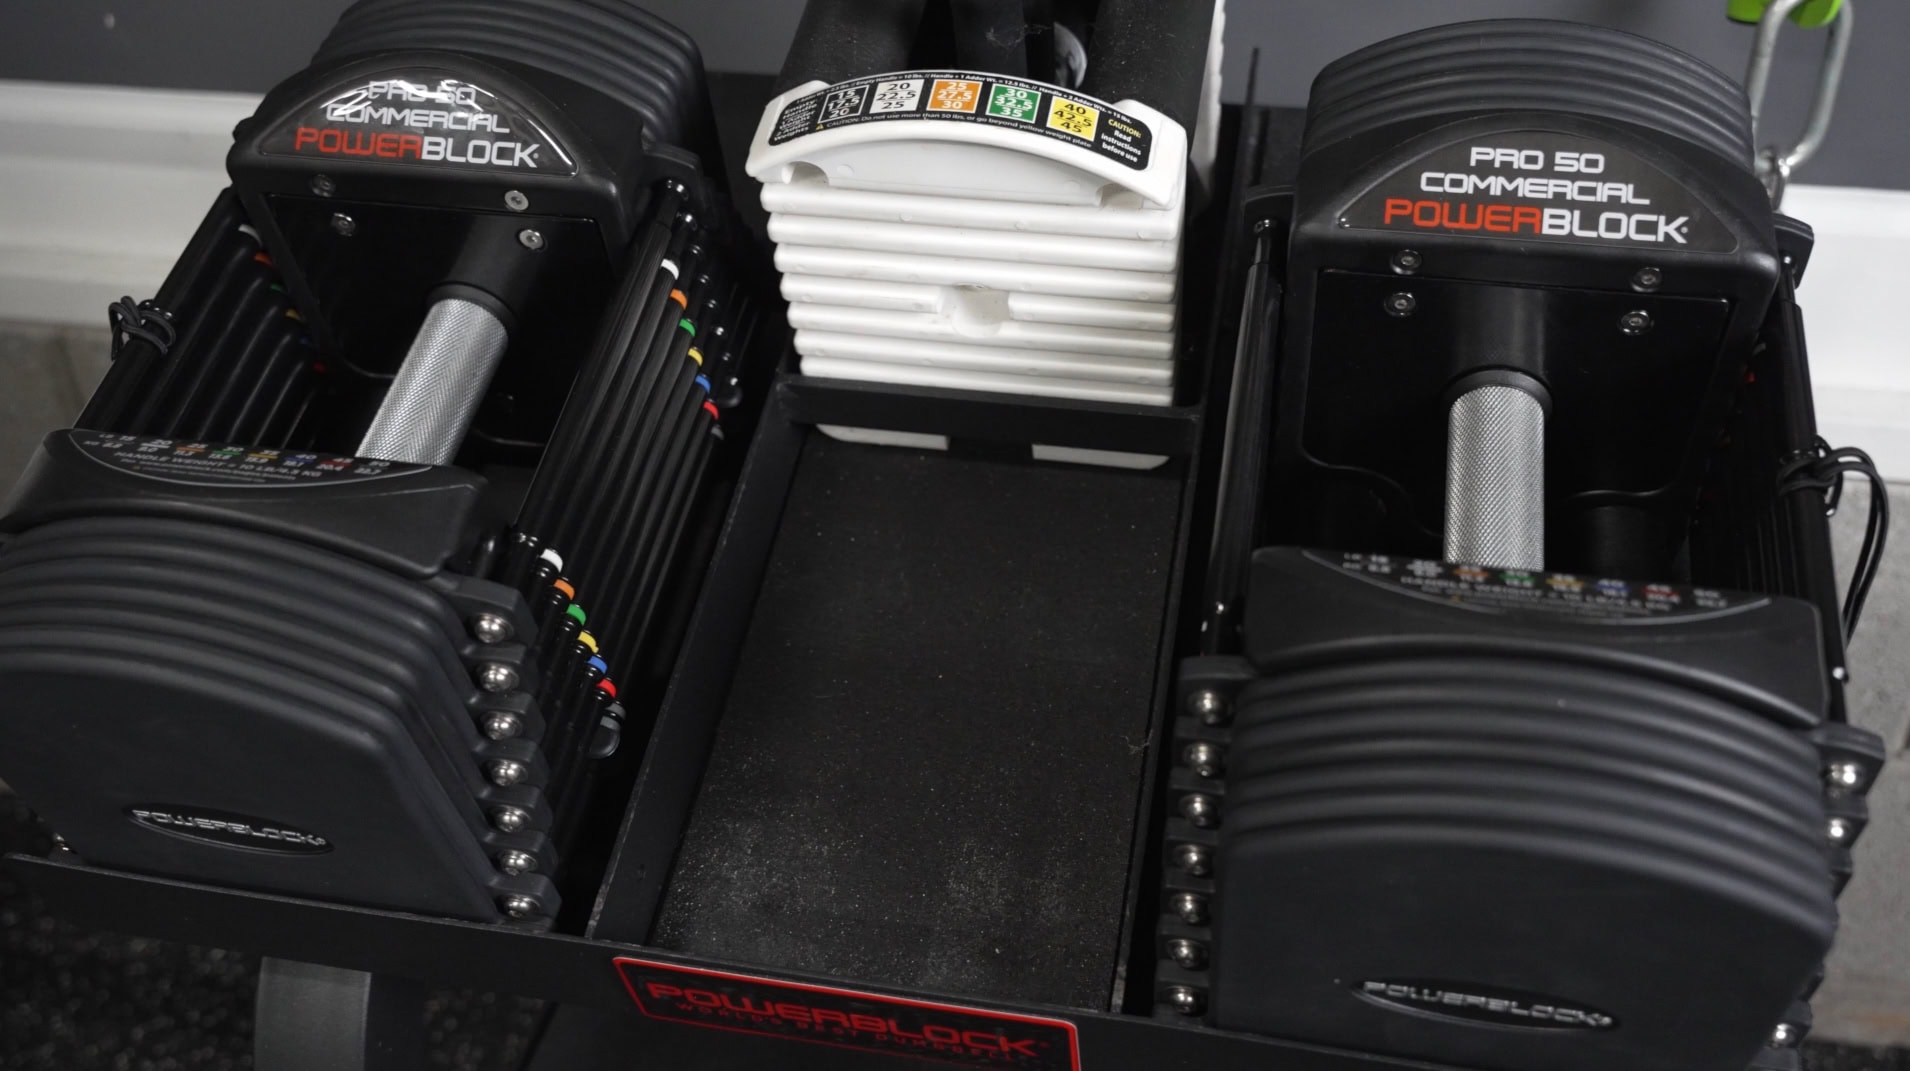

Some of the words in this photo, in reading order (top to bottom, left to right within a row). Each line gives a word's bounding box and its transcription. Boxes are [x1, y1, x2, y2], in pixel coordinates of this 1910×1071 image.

[930, 72, 955, 80] Handle
[964, 74, 986, 82] Adder
[888, 82, 910, 91] 20
[945, 82, 968, 91] 25
[838, 89, 857, 99] 15
[876, 91, 916, 101] 22.5
[937, 90, 973, 101] 27.5
[1005, 88, 1028, 99] 30
[828, 96, 860, 110] 17.5
[881, 101, 905, 110] 25
[941, 100, 963, 110] 30
[994, 95, 1033, 110] 32.5
[1064, 103, 1087, 115] 40
[829, 107, 850, 119] 20
[1000, 106, 1023, 118] 35
[1053, 110, 1093, 127] 42.5
[326, 104, 511, 134] COMMERCIAL
[988, 117, 1018, 127] beyond
[1018, 122, 1044, 133] yellow
[1045, 128, 1072, 141] weight
[1072, 136, 1093, 147] plate
[1060, 122, 1083, 134] 45
[1108, 118, 1142, 138] CAUTION:
[1114, 129, 1132, 142] Read
[295, 127, 540, 168] POWERBLOCK
[1101, 133, 1142, 155] instructions
[1101, 141, 1125, 157] before
[1125, 153, 1138, 162] use
[1470, 146, 1544, 171] PRO
[1553, 152, 1605, 174] 50
[1420, 171, 1650, 205] COMMERCIAL
[1384, 198, 1689, 244] POWERBLOCK
[132, 809, 321, 846] POWERBLOCK
[646, 980, 1039, 1058] POWERBLOCK
